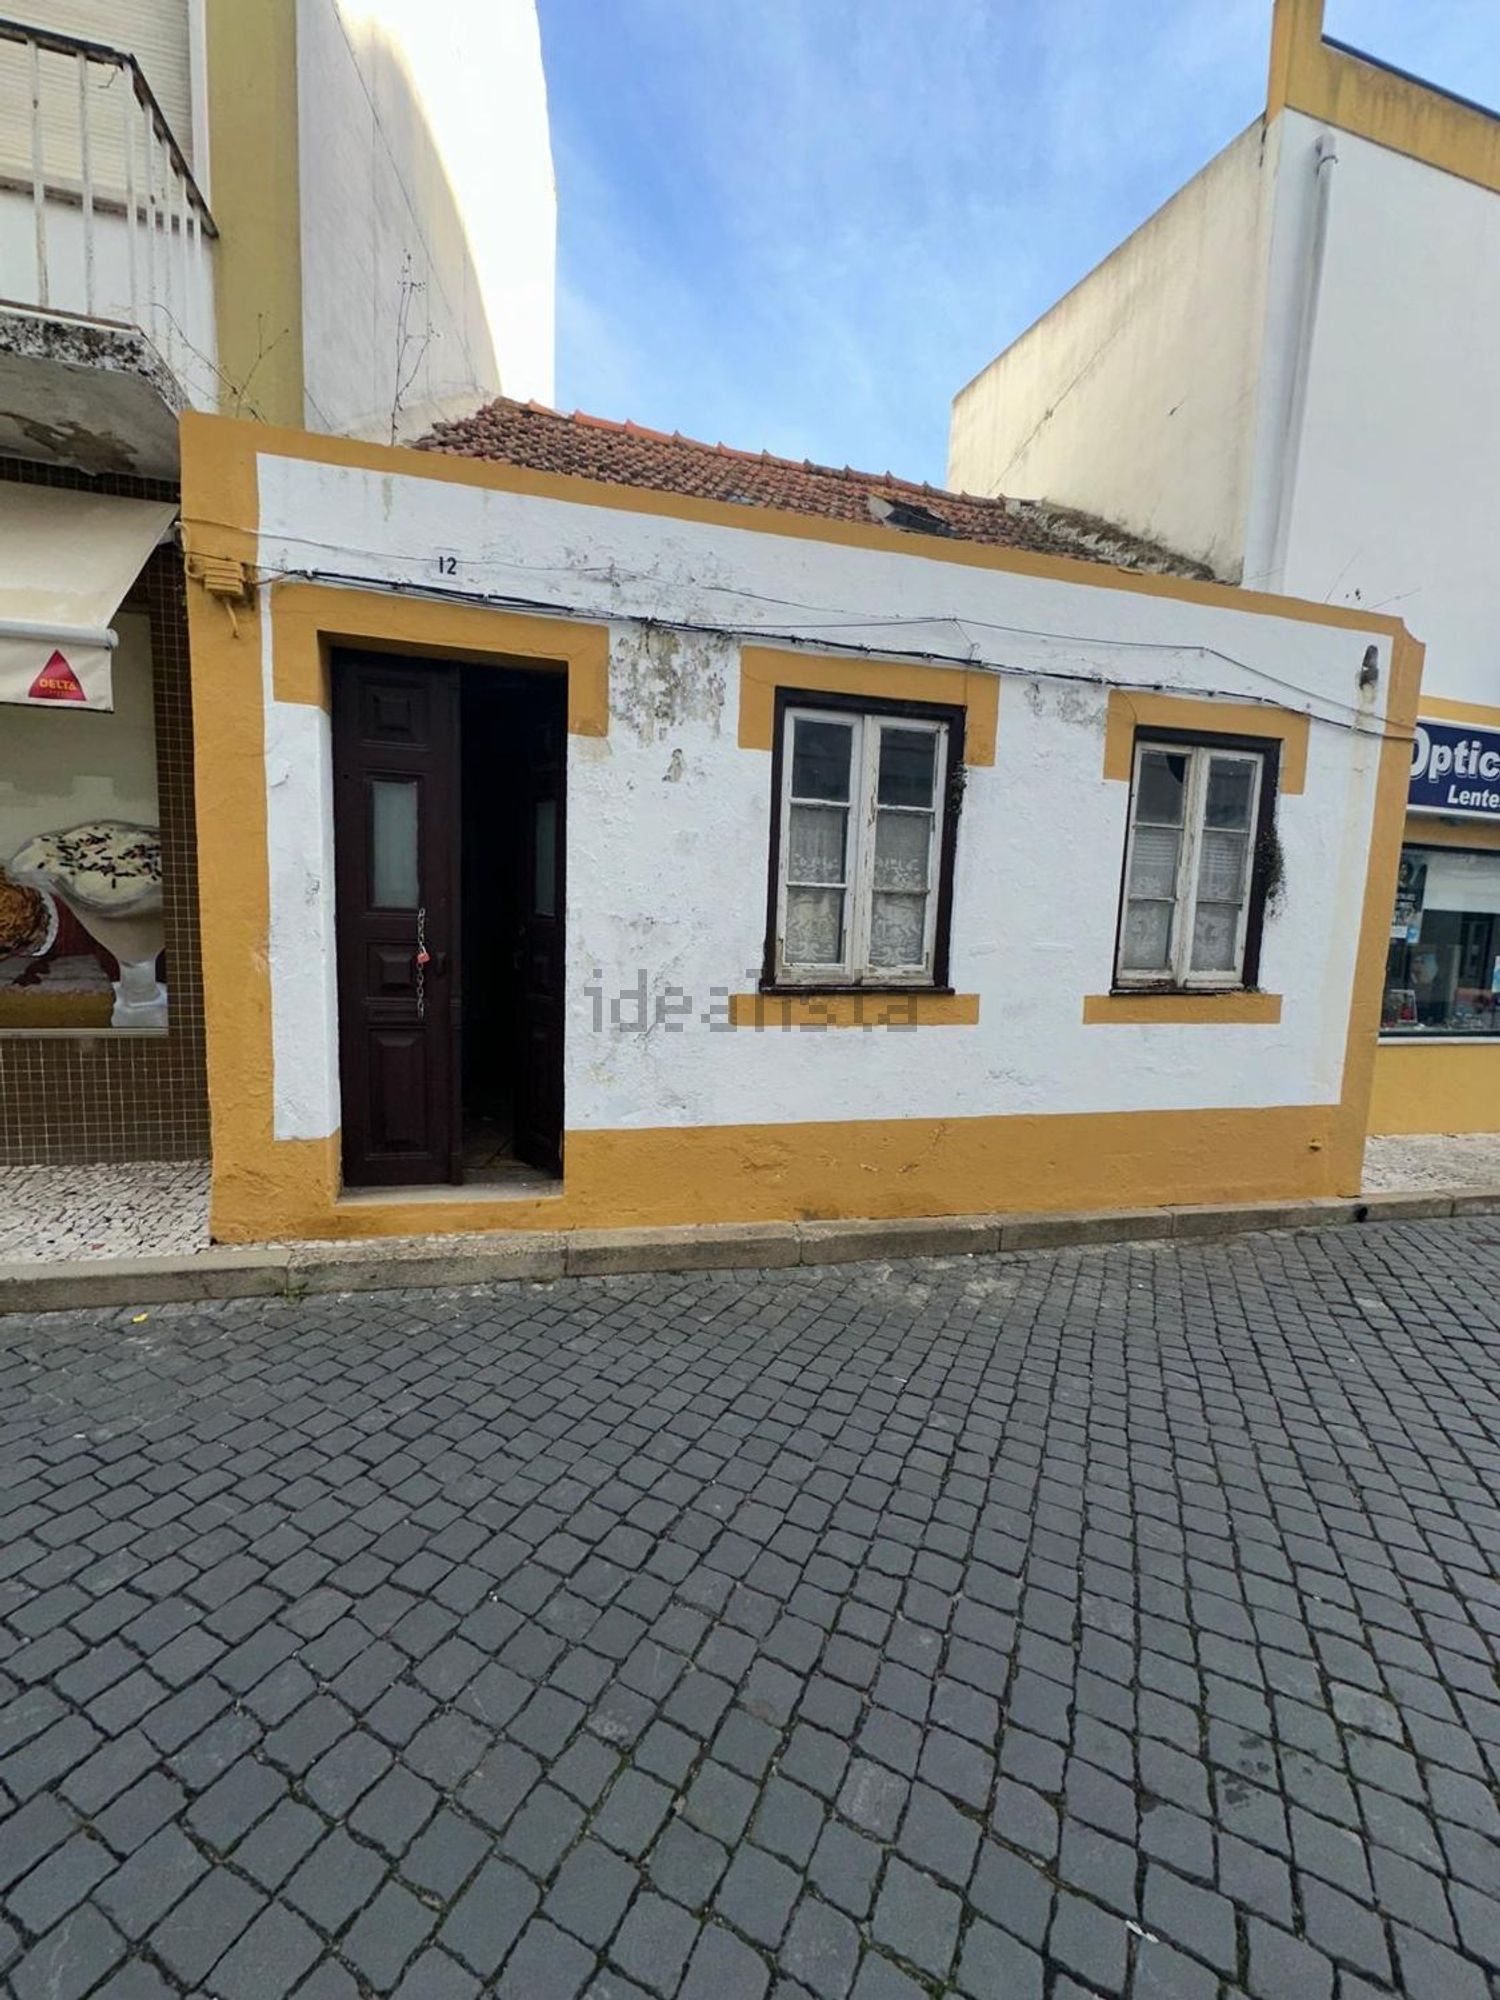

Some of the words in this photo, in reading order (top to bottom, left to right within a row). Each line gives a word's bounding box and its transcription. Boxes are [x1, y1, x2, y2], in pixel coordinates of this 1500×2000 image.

[439, 556, 457, 575] 12
[40, 679, 77, 691] DELTA
[1447, 784, 1500, 808] Lente
